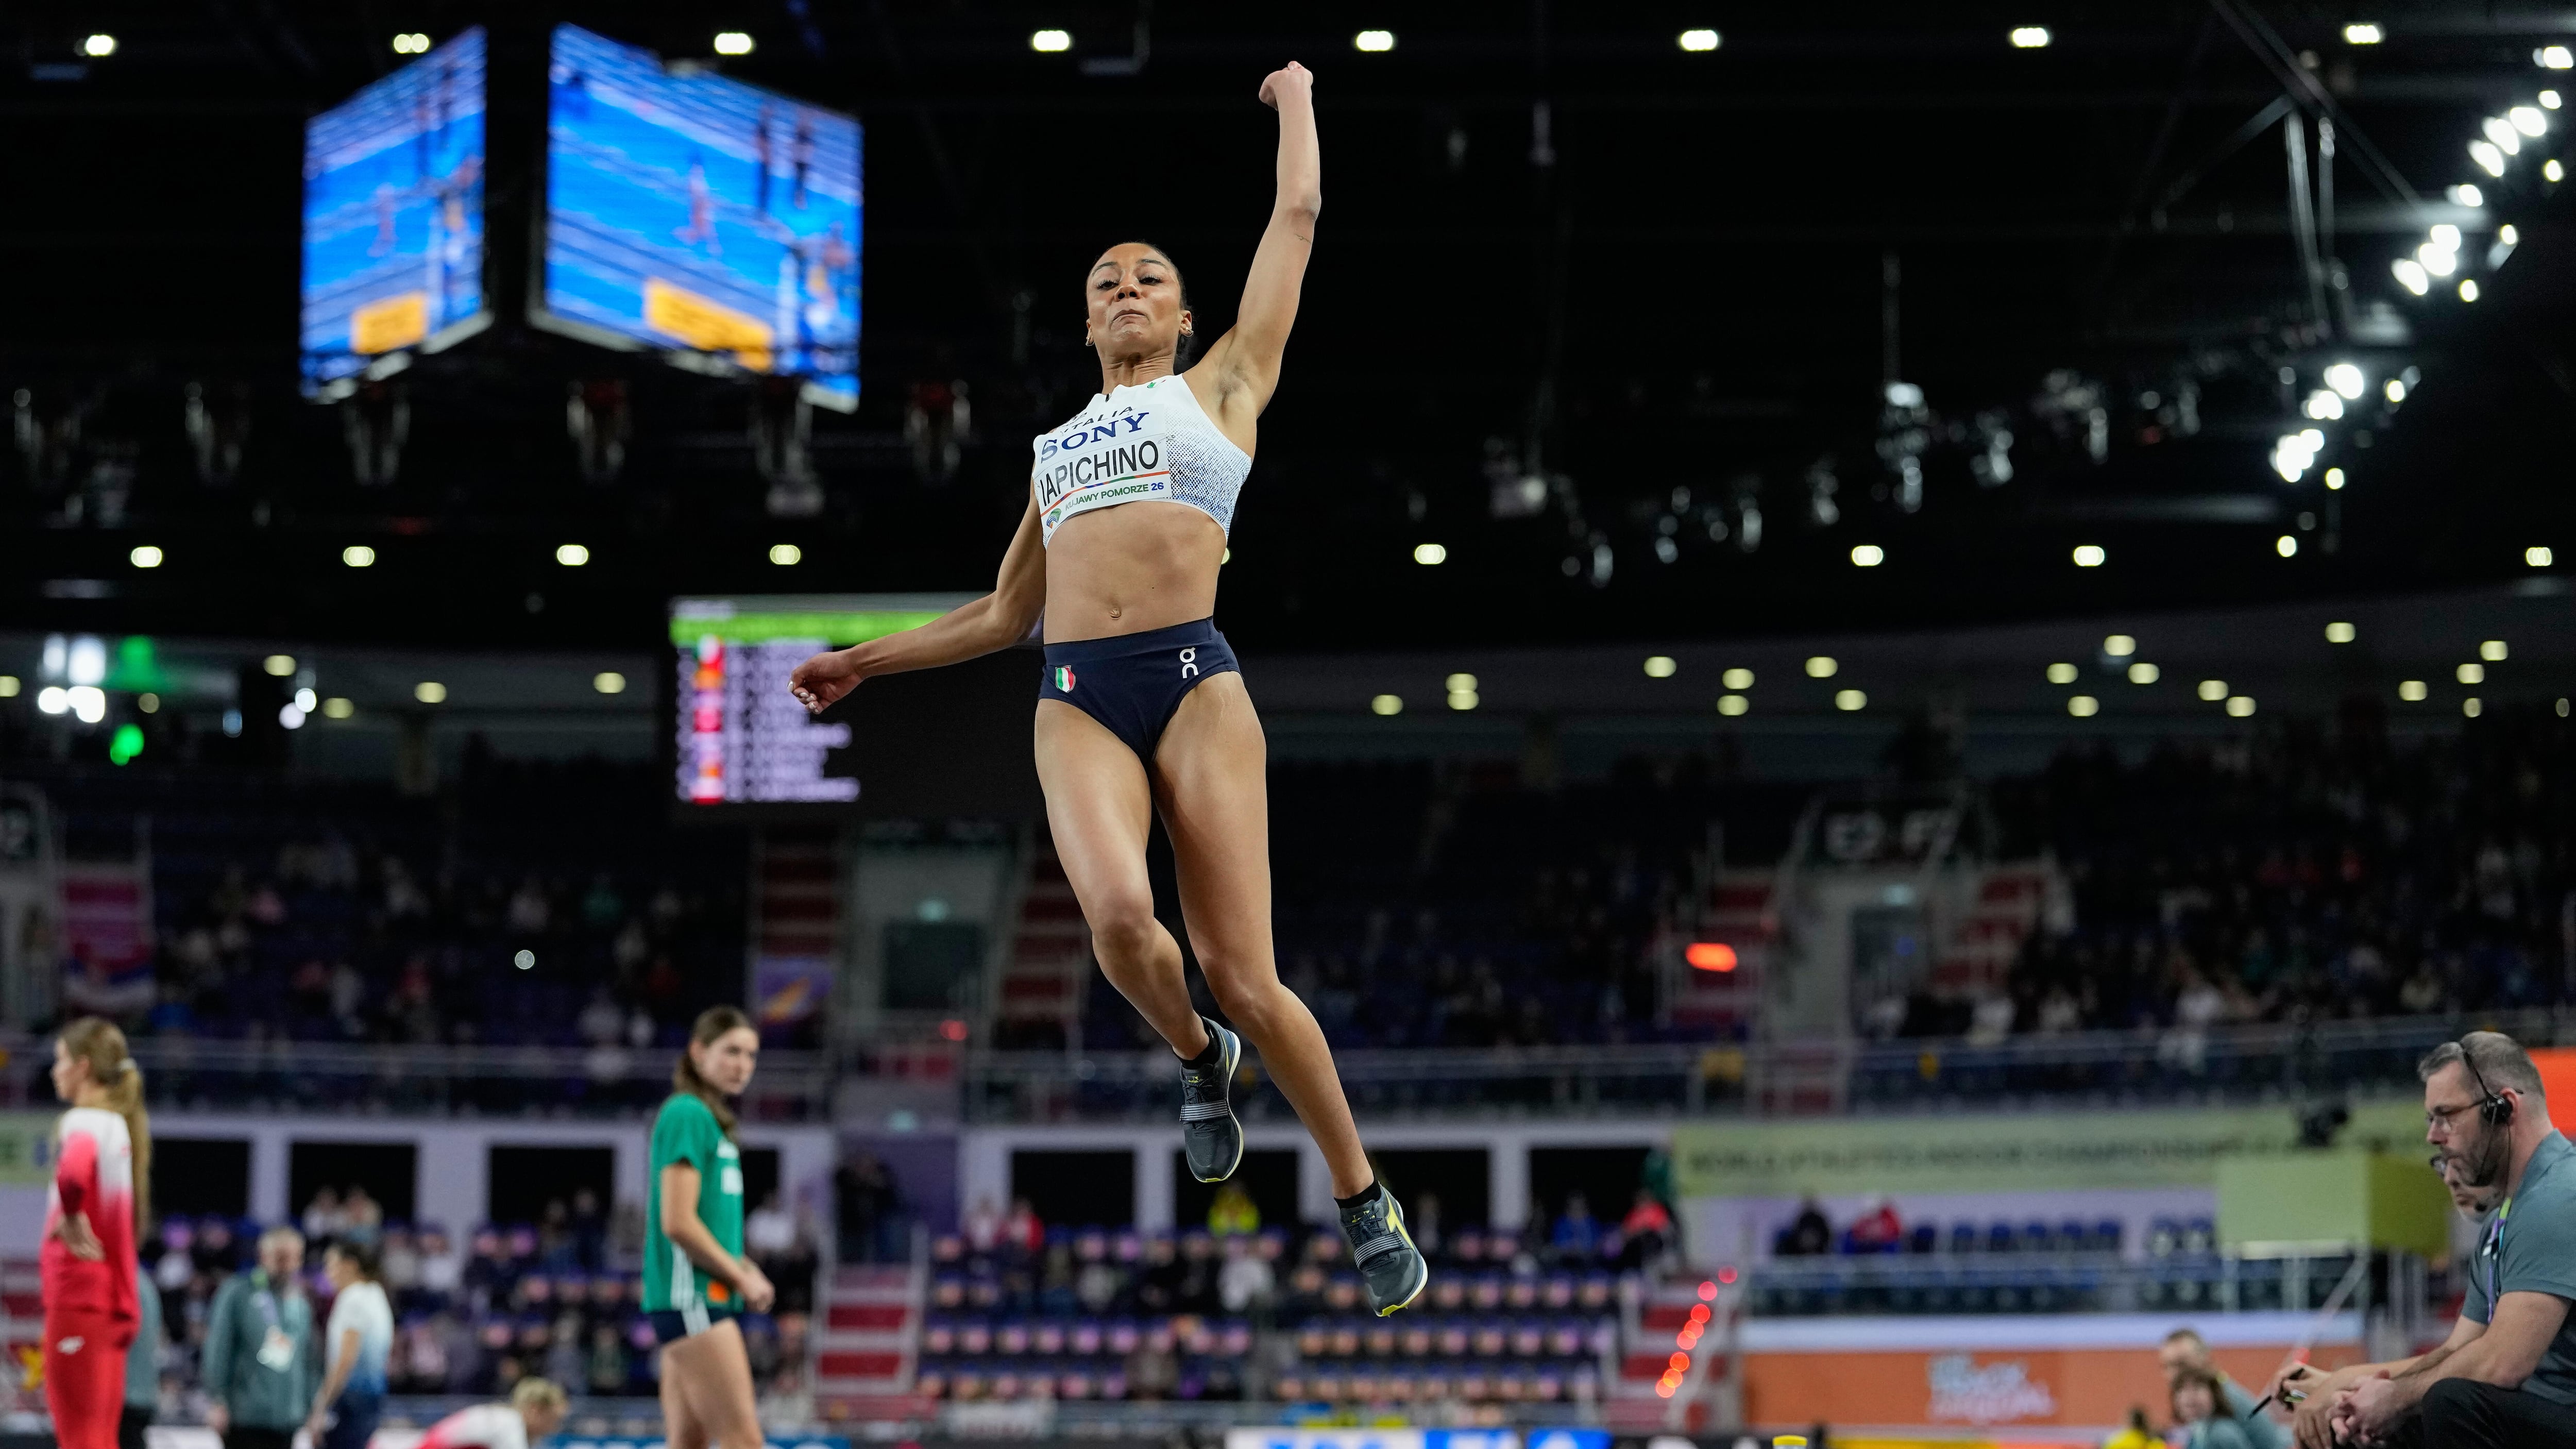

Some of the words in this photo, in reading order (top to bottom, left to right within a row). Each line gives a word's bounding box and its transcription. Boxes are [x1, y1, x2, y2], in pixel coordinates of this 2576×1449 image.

[1041, 412, 1149, 464] SONY
[1040, 441, 1159, 507] IAPICHINO
[1065, 493, 1099, 511] KUJAWY
[1101, 484, 1149, 499] POMORZE
[1150, 482, 1164, 491] 26
